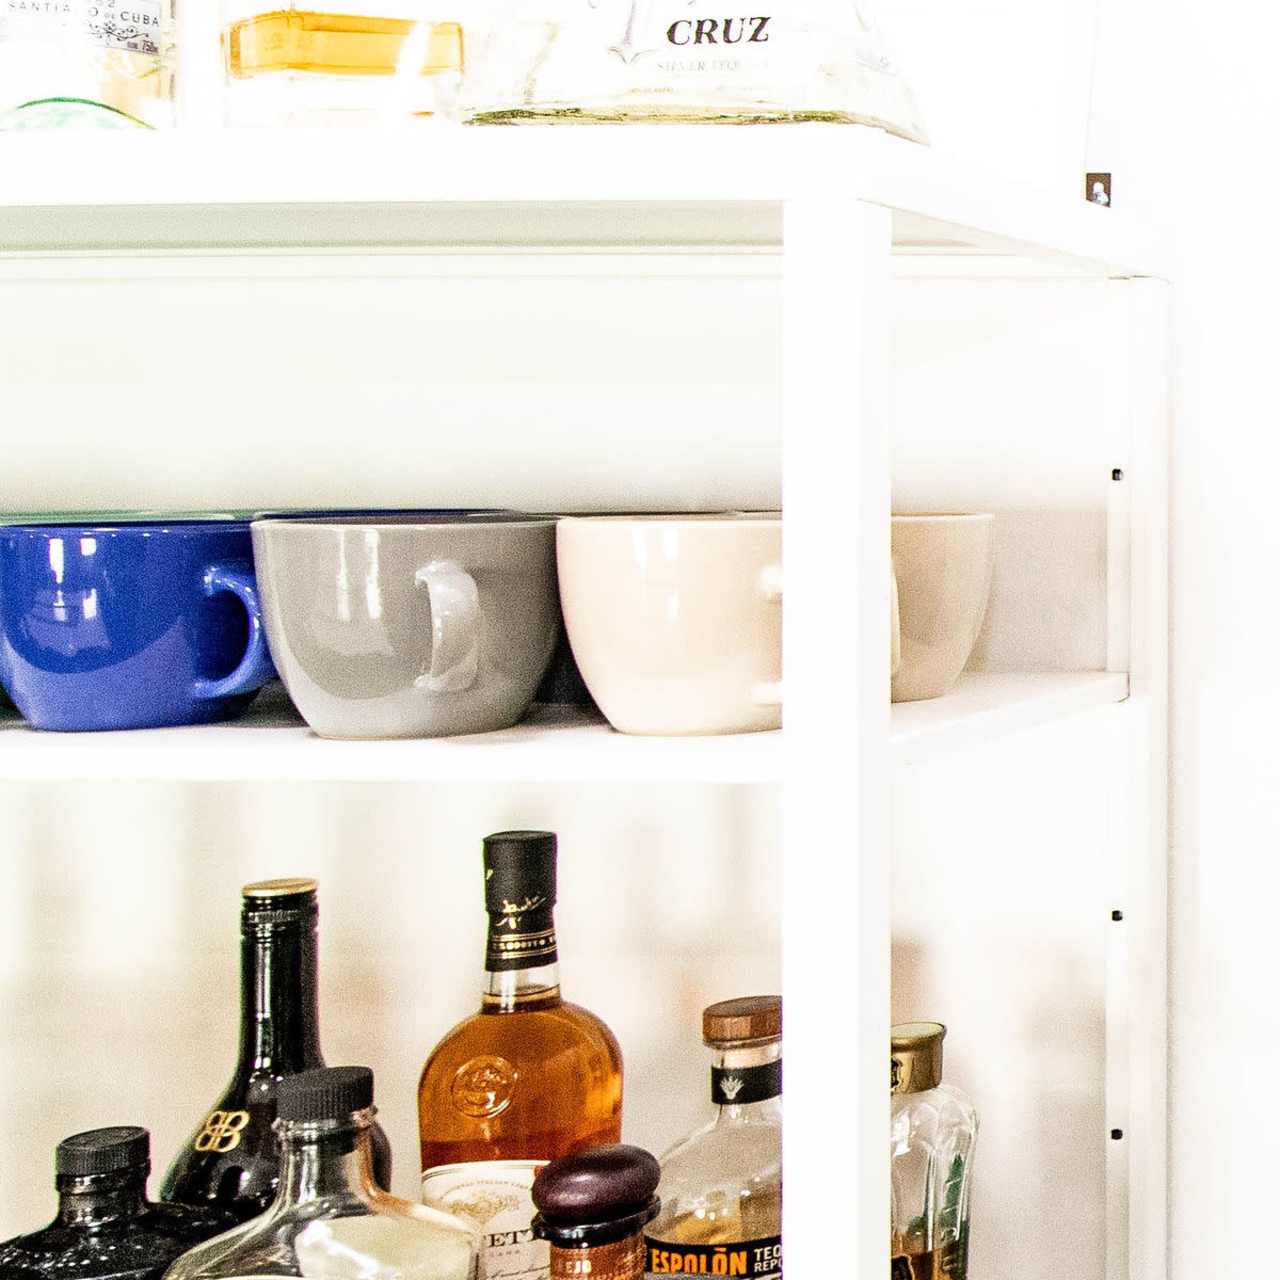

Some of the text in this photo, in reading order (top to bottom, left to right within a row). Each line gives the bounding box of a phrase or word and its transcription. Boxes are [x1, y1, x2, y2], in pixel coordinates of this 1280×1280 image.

[119, 10, 160, 26] CUBA
[666, 16, 771, 46] CRUZ
[753, 1259, 782, 1273] REP
